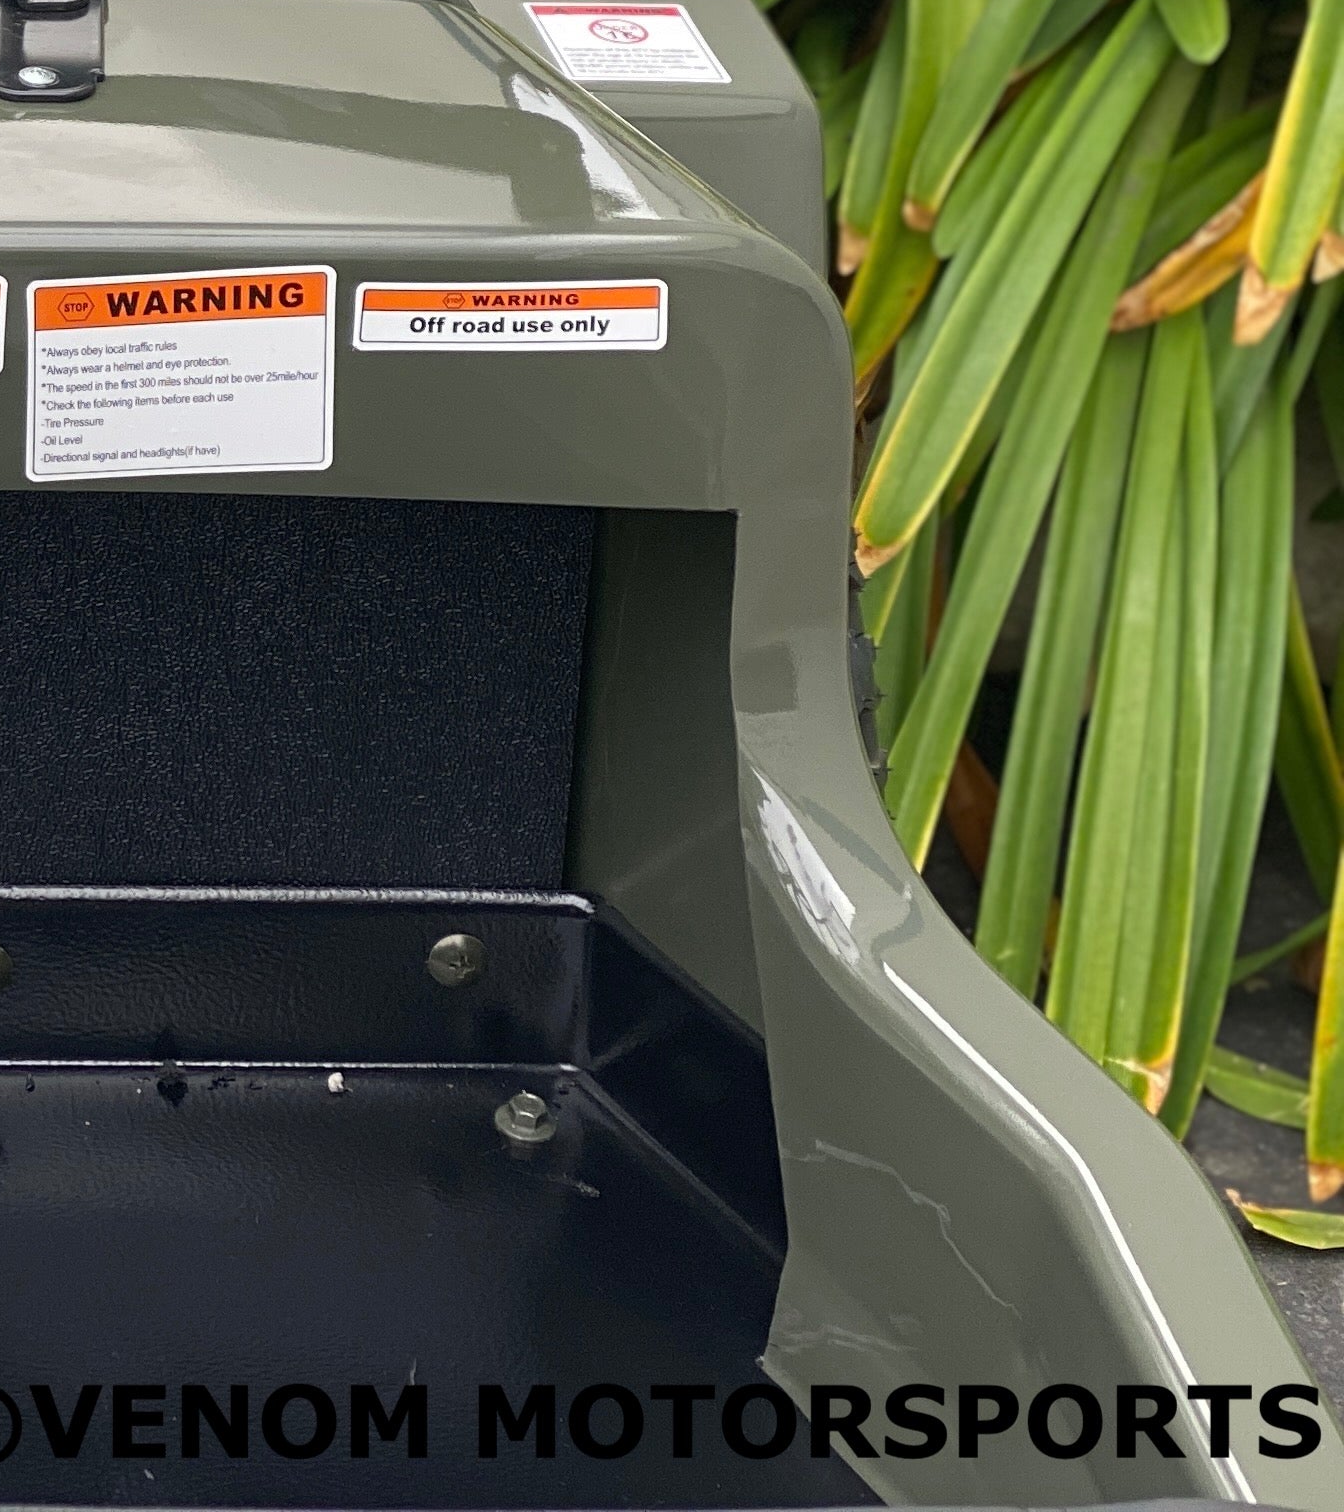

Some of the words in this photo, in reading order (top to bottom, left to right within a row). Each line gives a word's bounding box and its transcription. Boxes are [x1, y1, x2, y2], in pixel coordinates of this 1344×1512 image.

[63, 302, 88, 313] STOP
[106, 282, 304, 318] WARNING
[472, 293, 579, 307] WARNING
[410, 316, 445, 334] Off
[452, 317, 505, 333] road
[512, 318, 554, 333] use
[560, 315, 610, 336] only
[81, 346, 103, 357] obey
[105, 343, 127, 354] local
[129, 342, 153, 353] traffic
[155, 341, 177, 351] rules
[81, 364, 103, 373] wear
[105, 364, 111, 372] a
[113, 361, 144, 371] helmet
[146, 360, 163, 369] and
[165, 360, 182, 371] eye
[66, 381, 93, 394] speed
[95, 380, 103, 390] in
[105, 380, 119, 390] the
[121, 379, 137, 388] first
[139, 377, 156, 388] 300
[158, 377, 181, 386] miles
[183, 374, 213, 386] should
[215, 374, 229, 384] not
[231, 374, 242, 383] be
[244, 374, 265, 383] over
[77, 399, 91, 409] the
[93, 397, 133, 409] following
[135, 397, 159, 406] items
[161, 393, 191, 404] before
[193, 392, 215, 402] each
[217, 392, 234, 402] use
[63, 417, 104, 427] Pressure
[58, 434, 83, 445] Level
[92, 451, 118, 462] signal
[120, 449, 138, 459] and
[195, 445, 220, 457] have)
